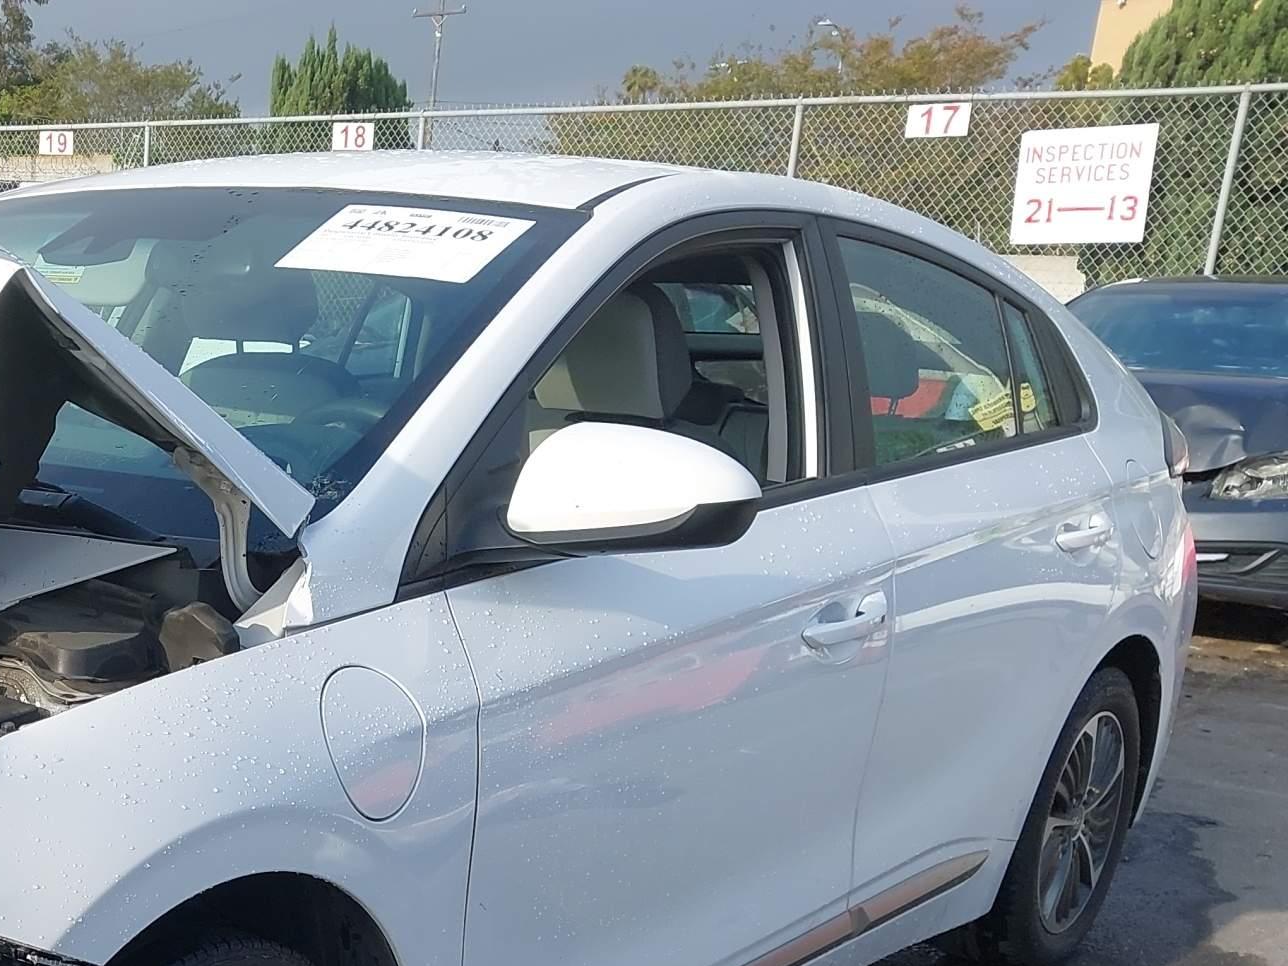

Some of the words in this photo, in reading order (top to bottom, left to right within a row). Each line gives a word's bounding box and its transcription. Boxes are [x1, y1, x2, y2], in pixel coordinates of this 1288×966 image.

[920, 105, 961, 135] 17
[46, 132, 67, 153] 19
[340, 125, 366, 148] 18
[1025, 141, 1144, 164] INSPECTION
[1035, 163, 1130, 184] SERVICES
[341, 218, 495, 242] 44824108
